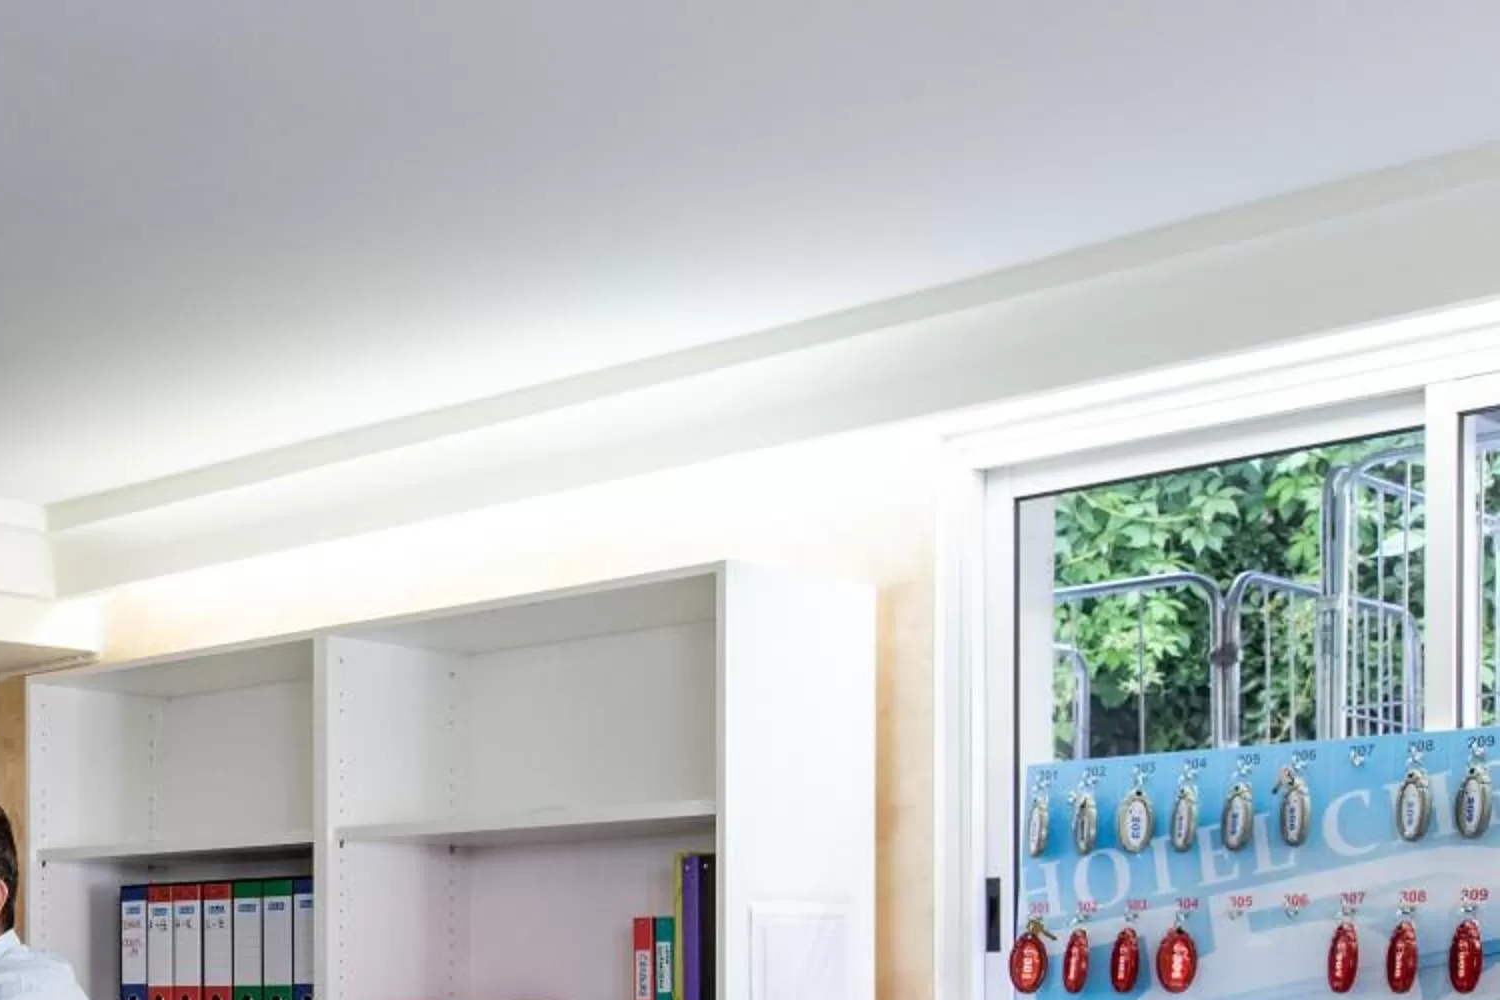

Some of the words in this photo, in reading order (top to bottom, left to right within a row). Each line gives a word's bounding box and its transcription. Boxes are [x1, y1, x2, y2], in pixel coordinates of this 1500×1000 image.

[1467, 735, 1496, 748] 209
[1021, 813, 1296, 916] HOTEL
[1461, 888, 1489, 901] 309
